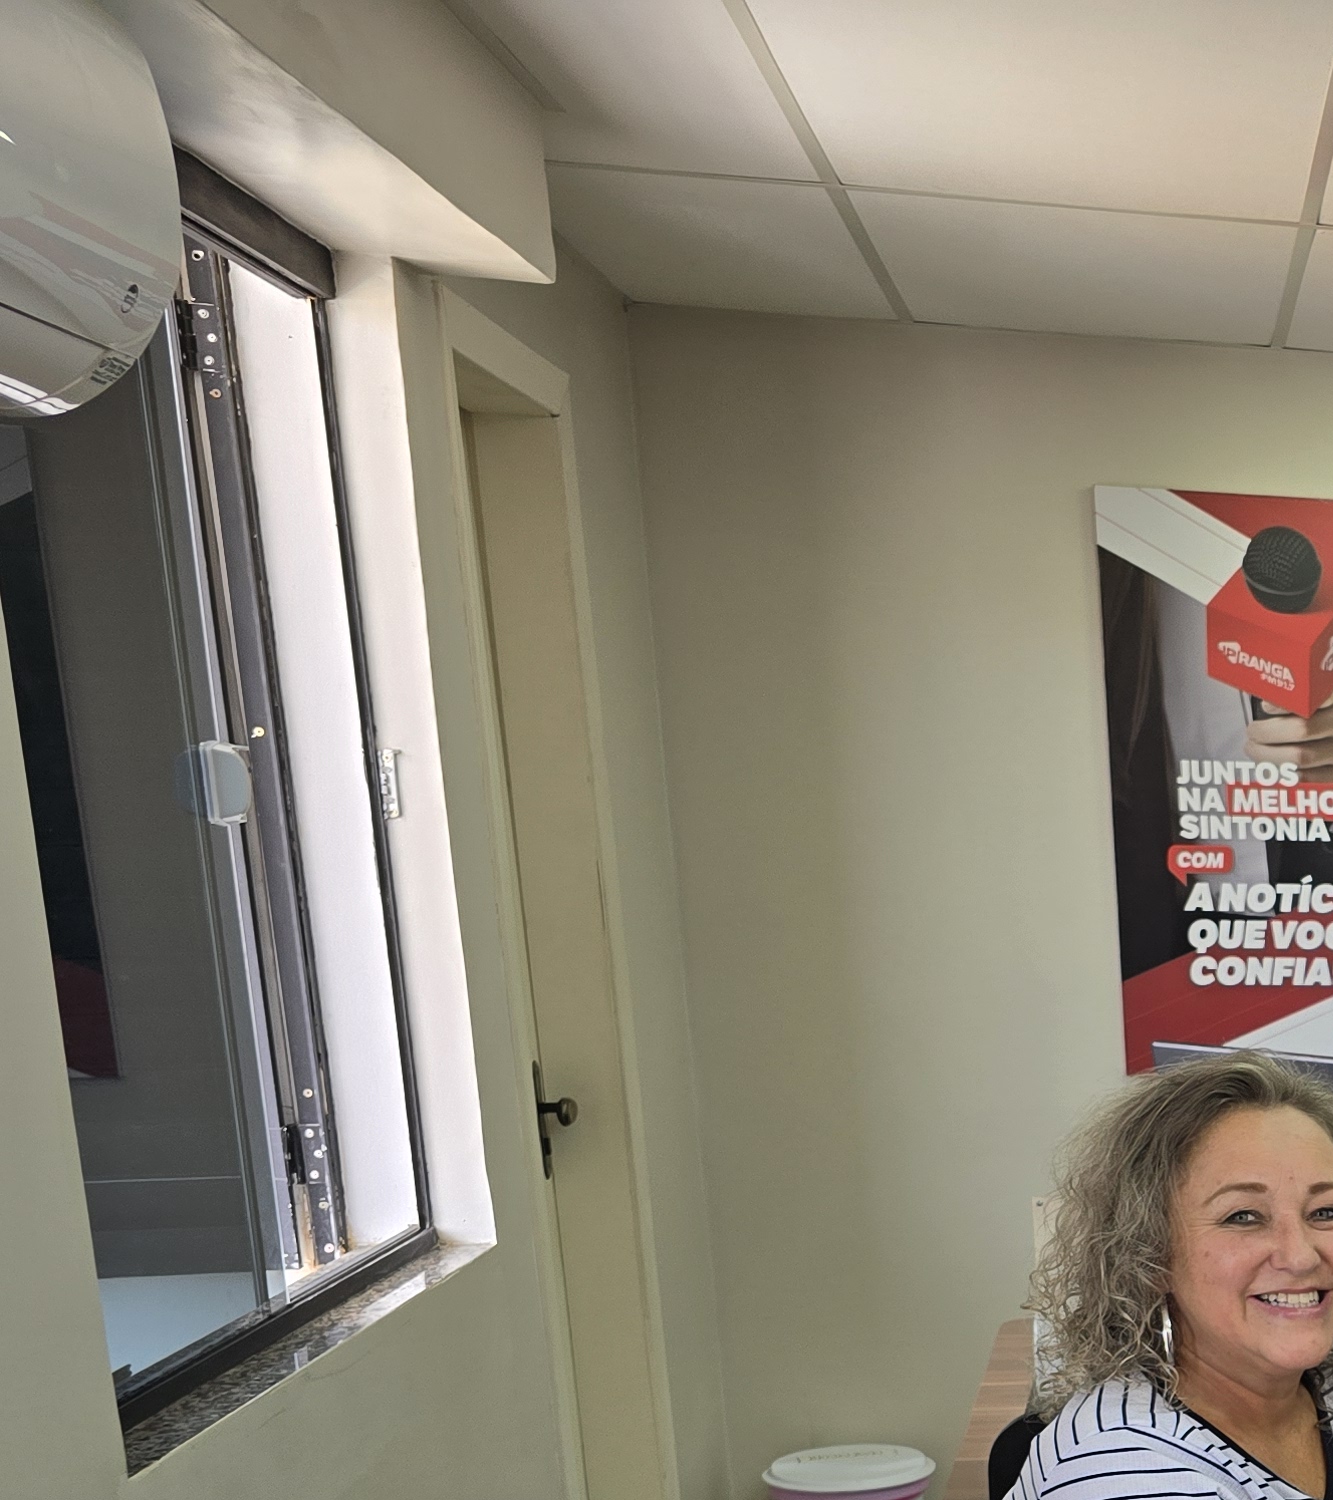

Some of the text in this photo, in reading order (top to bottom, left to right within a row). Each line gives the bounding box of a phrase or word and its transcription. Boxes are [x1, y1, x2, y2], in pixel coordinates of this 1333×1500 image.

[1177, 760, 1298, 786] JUNTOS
[1178, 788, 1224, 813] NA
[1179, 816, 1330, 842] SINTONIA
[1176, 849, 1225, 870] COM
[1185, 884, 1214, 911] A
[1188, 919, 1265, 953] QUE
